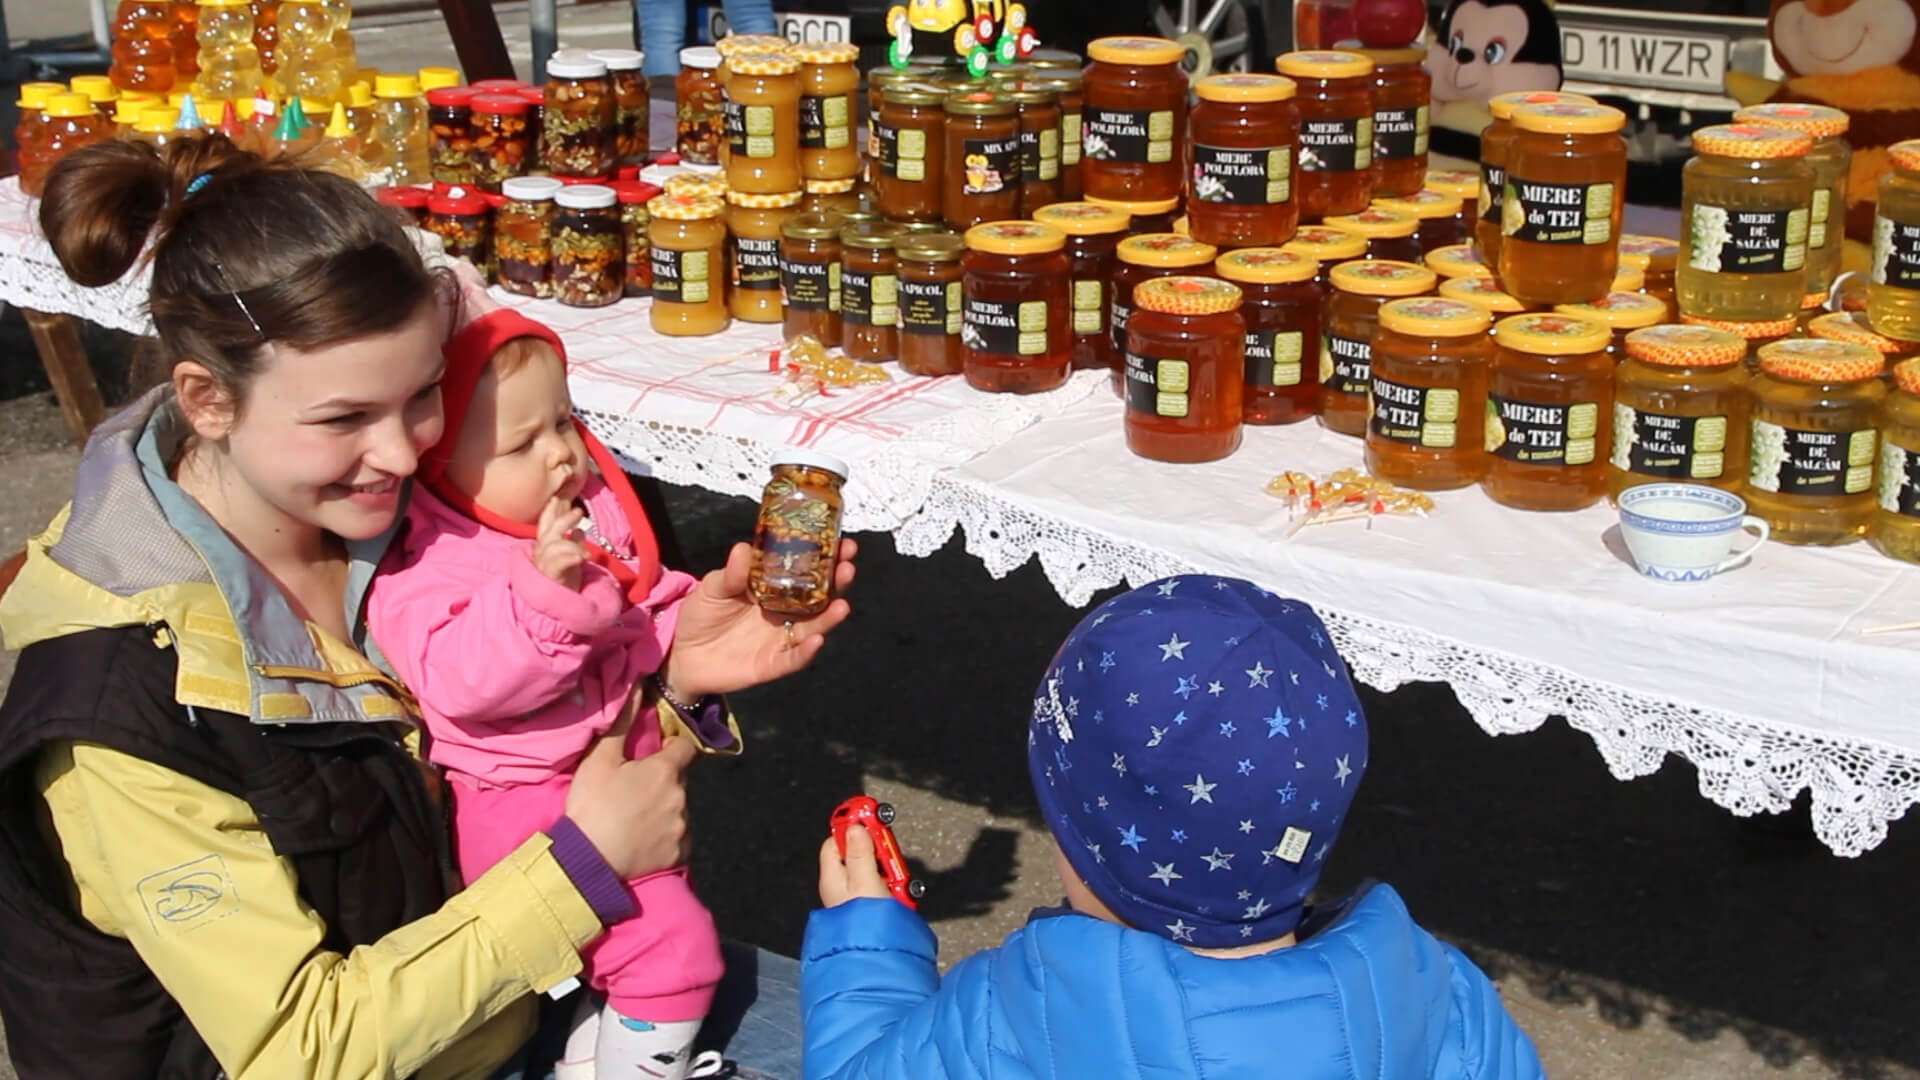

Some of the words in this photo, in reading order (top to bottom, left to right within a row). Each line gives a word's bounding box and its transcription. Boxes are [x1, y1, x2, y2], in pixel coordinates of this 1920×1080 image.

[783, 19, 842, 44] GCD
[1599, 35, 1620, 70] 11
[1631, 38, 1712, 77] WZR
[1100, 112, 1134, 125] MIERE
[1308, 123, 1344, 134] MIERE
[1215, 152, 1252, 164] MIERE
[1521, 185, 1581, 205] MIERE
[1528, 209, 1545, 224] de
[1547, 210, 1581, 227] TEI
[1738, 213, 1775, 224] MIERE
[1749, 225, 1767, 237] DE
[738, 238, 777, 252] MIERE
[971, 301, 1003, 315] MIERE
[1332, 338, 1371, 360] MIER
[1336, 361, 1350, 376] de
[1373, 379, 1421, 406] MIERE
[1389, 406, 1420, 427] TEI
[1502, 402, 1563, 425] MIERE
[1644, 415, 1681, 429] MIERE
[1508, 427, 1526, 444] de
[1527, 429, 1562, 447] TEI
[1655, 429, 1672, 441] DE
[1797, 432, 1836, 445] MIERE
[1808, 446, 1827, 458] DE
